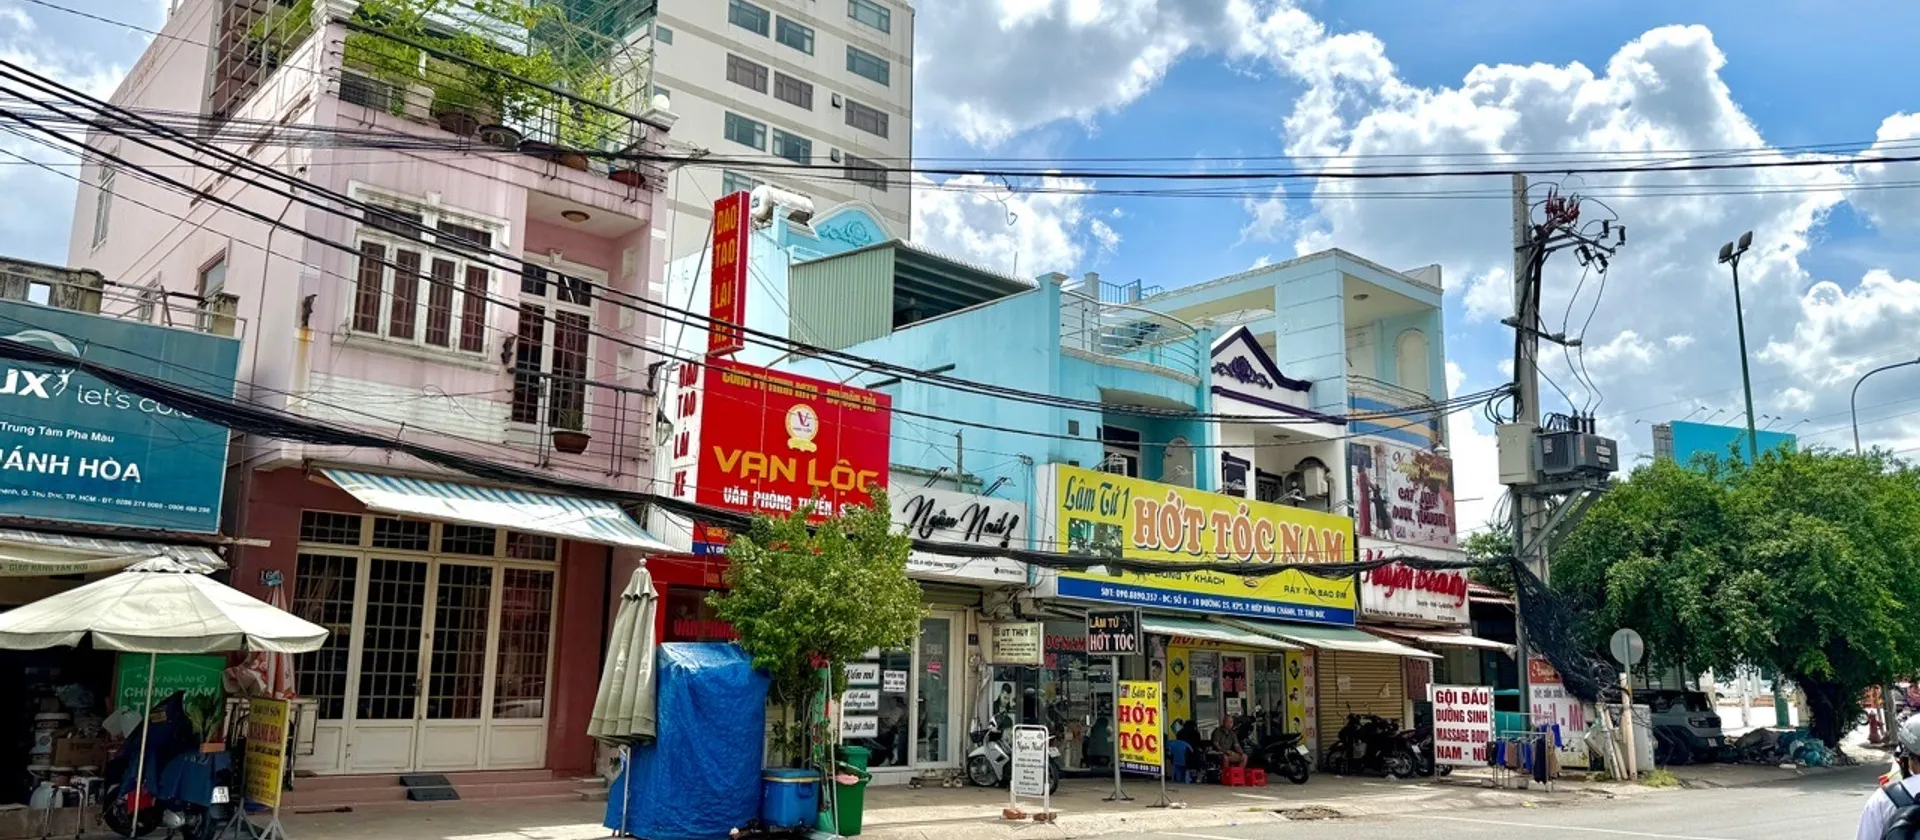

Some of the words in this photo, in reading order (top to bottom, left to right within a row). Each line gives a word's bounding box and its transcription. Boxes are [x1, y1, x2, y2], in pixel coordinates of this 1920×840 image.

[78, 384, 131, 410] let's
[1, 421, 35, 436] Trung
[66, 429, 88, 440] Pha
[78, 456, 141, 483] HÒA
[713, 445, 797, 484] VẠN
[807, 459, 879, 496] LỘC
[673, 471, 687, 497] XE
[723, 484, 748, 505] VĂN
[752, 490, 792, 511] PHÒNG
[1063, 476, 1096, 511] Lâm
[1122, 487, 1131, 519] 1
[903, 494, 959, 539] Ngân
[1132, 490, 1205, 556] HỚT
[1211, 504, 1275, 564] TÓC
[1279, 521, 1346, 564] NAM
[1090, 629, 1111, 651] HỚT
[1113, 629, 1134, 651] TÓC
[1436, 688, 1458, 706] GỘI
[1119, 701, 1157, 726] HỚT
[1467, 709, 1488, 724] SINH
[1436, 728, 1469, 742] MASSAGE
[1437, 745, 1462, 761] NAM
